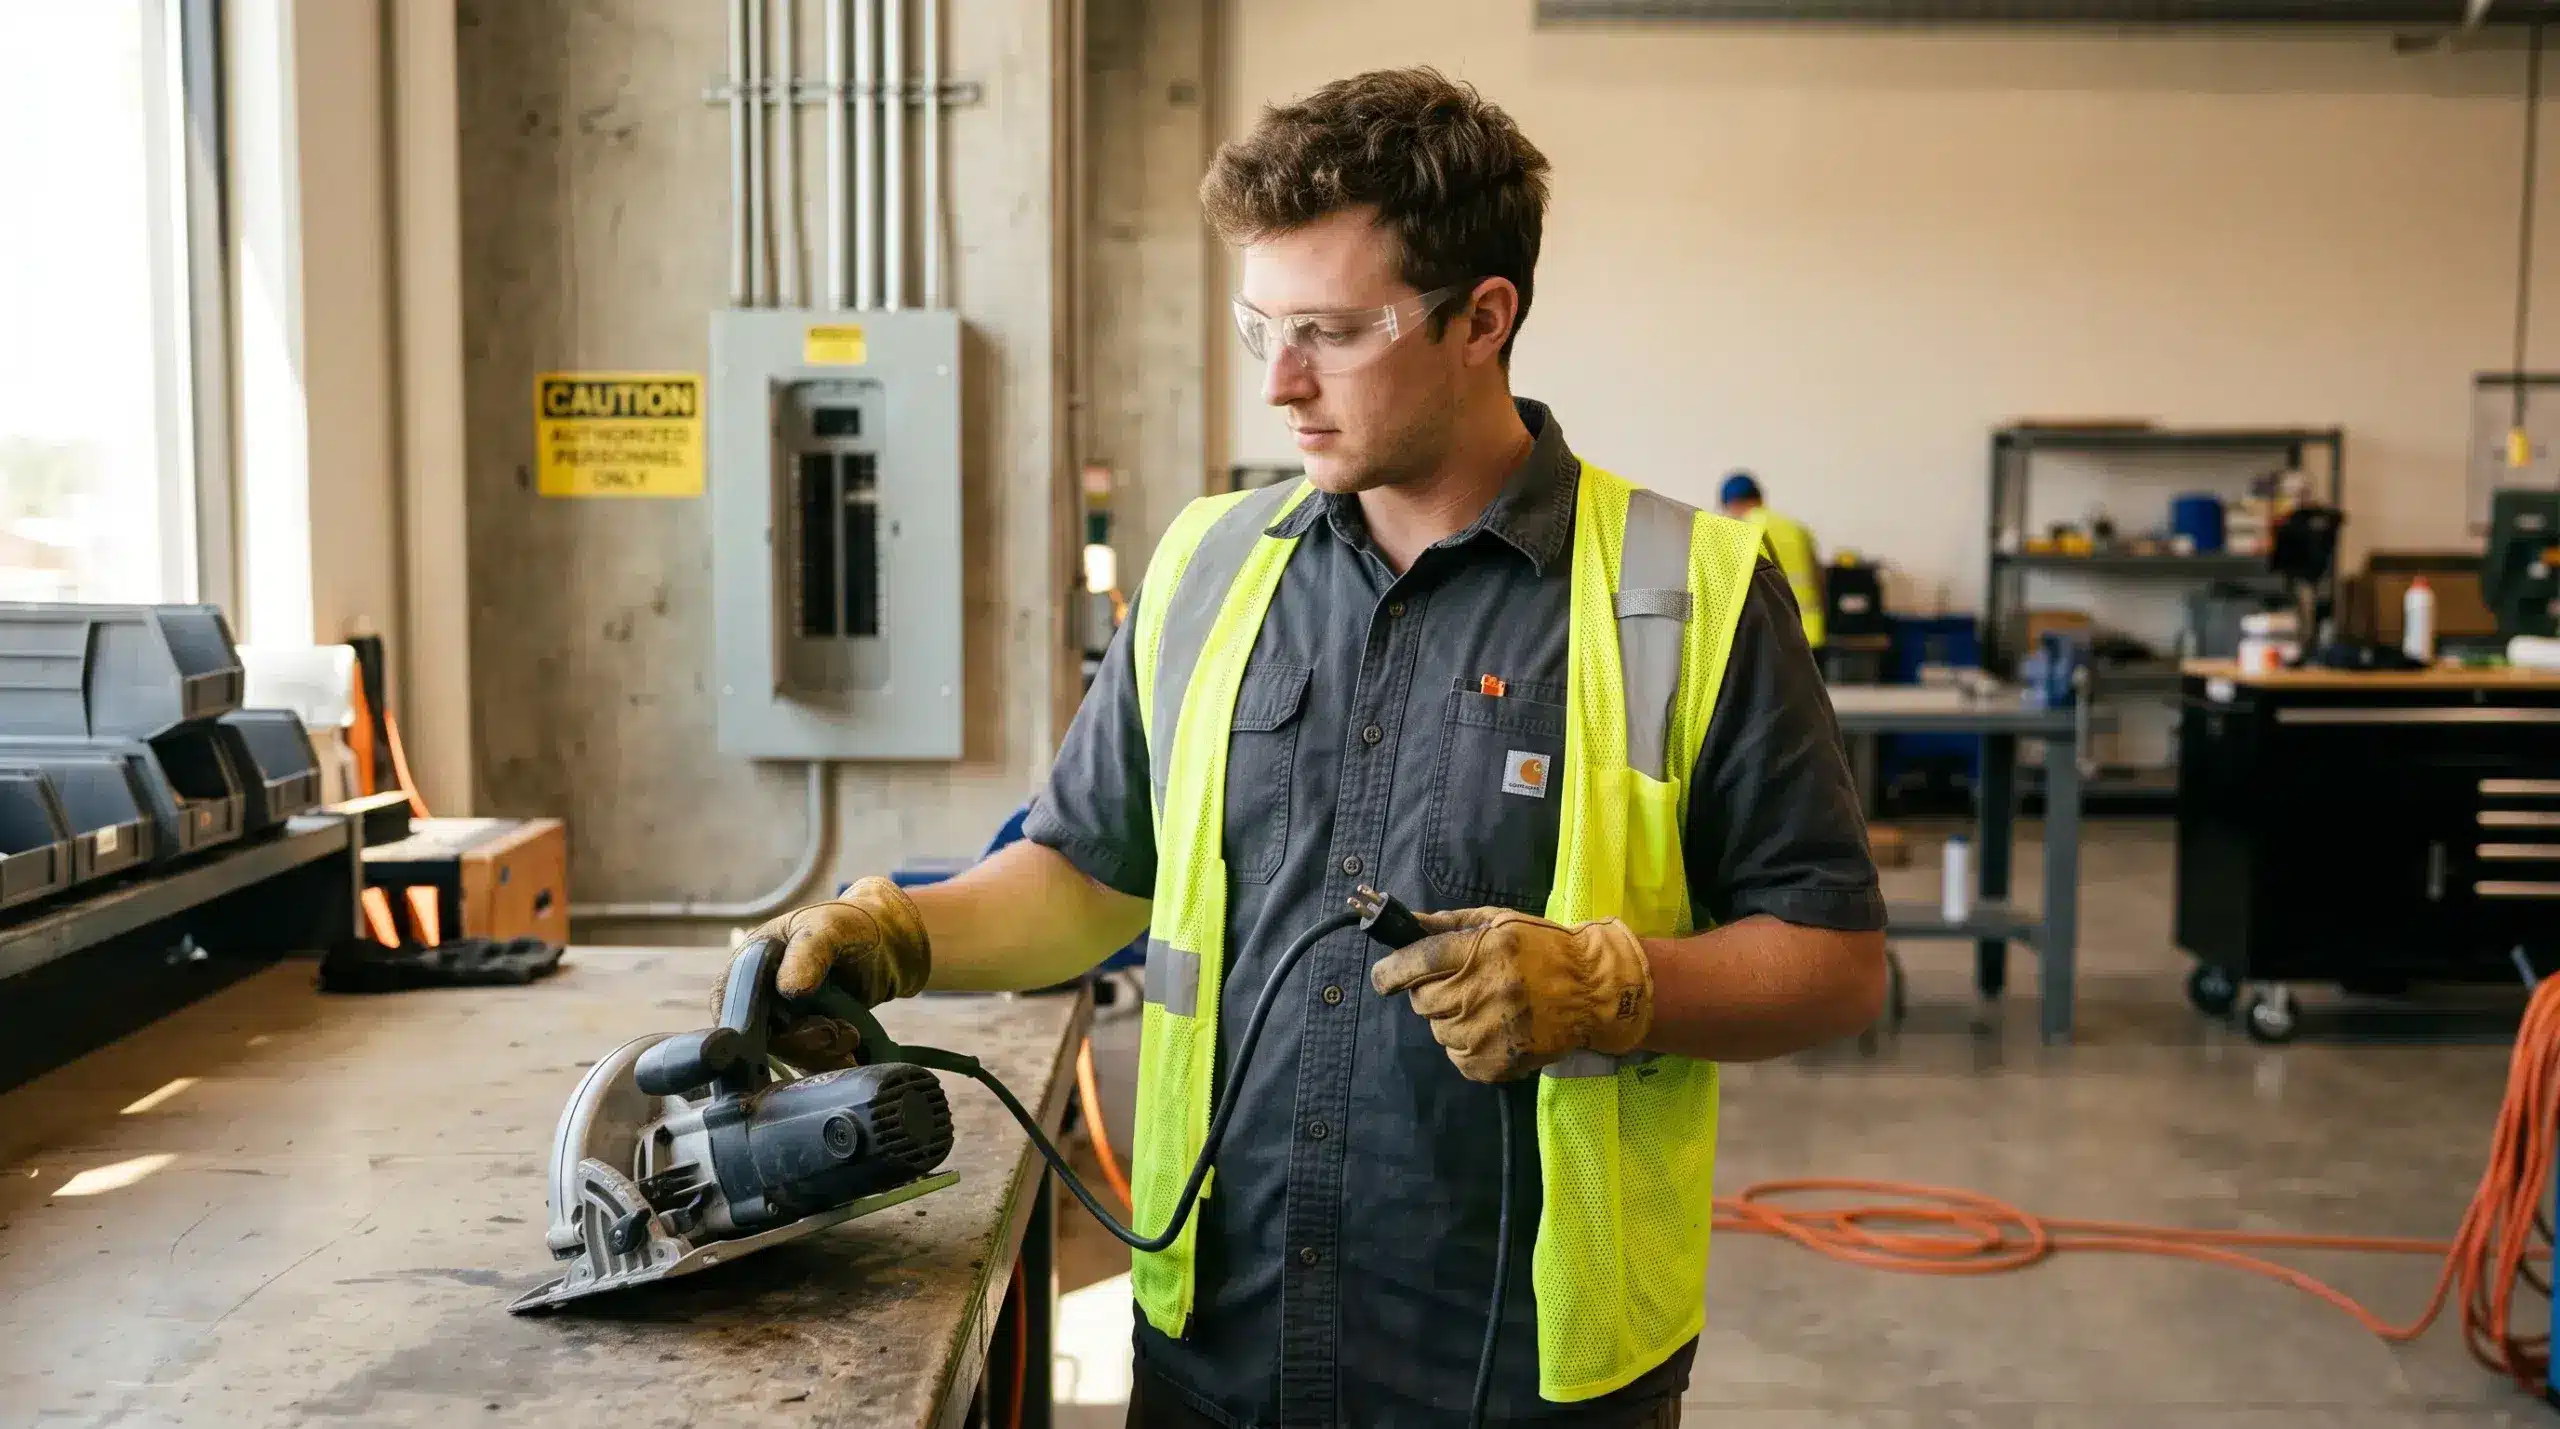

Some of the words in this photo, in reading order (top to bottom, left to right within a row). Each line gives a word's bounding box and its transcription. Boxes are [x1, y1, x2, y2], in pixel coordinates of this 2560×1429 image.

[546, 384, 692, 417] CAUTION
[551, 426, 689, 443] AUTHORIZED
[553, 449, 684, 467] PERSONNEL
[593, 470, 647, 488] ONLY
